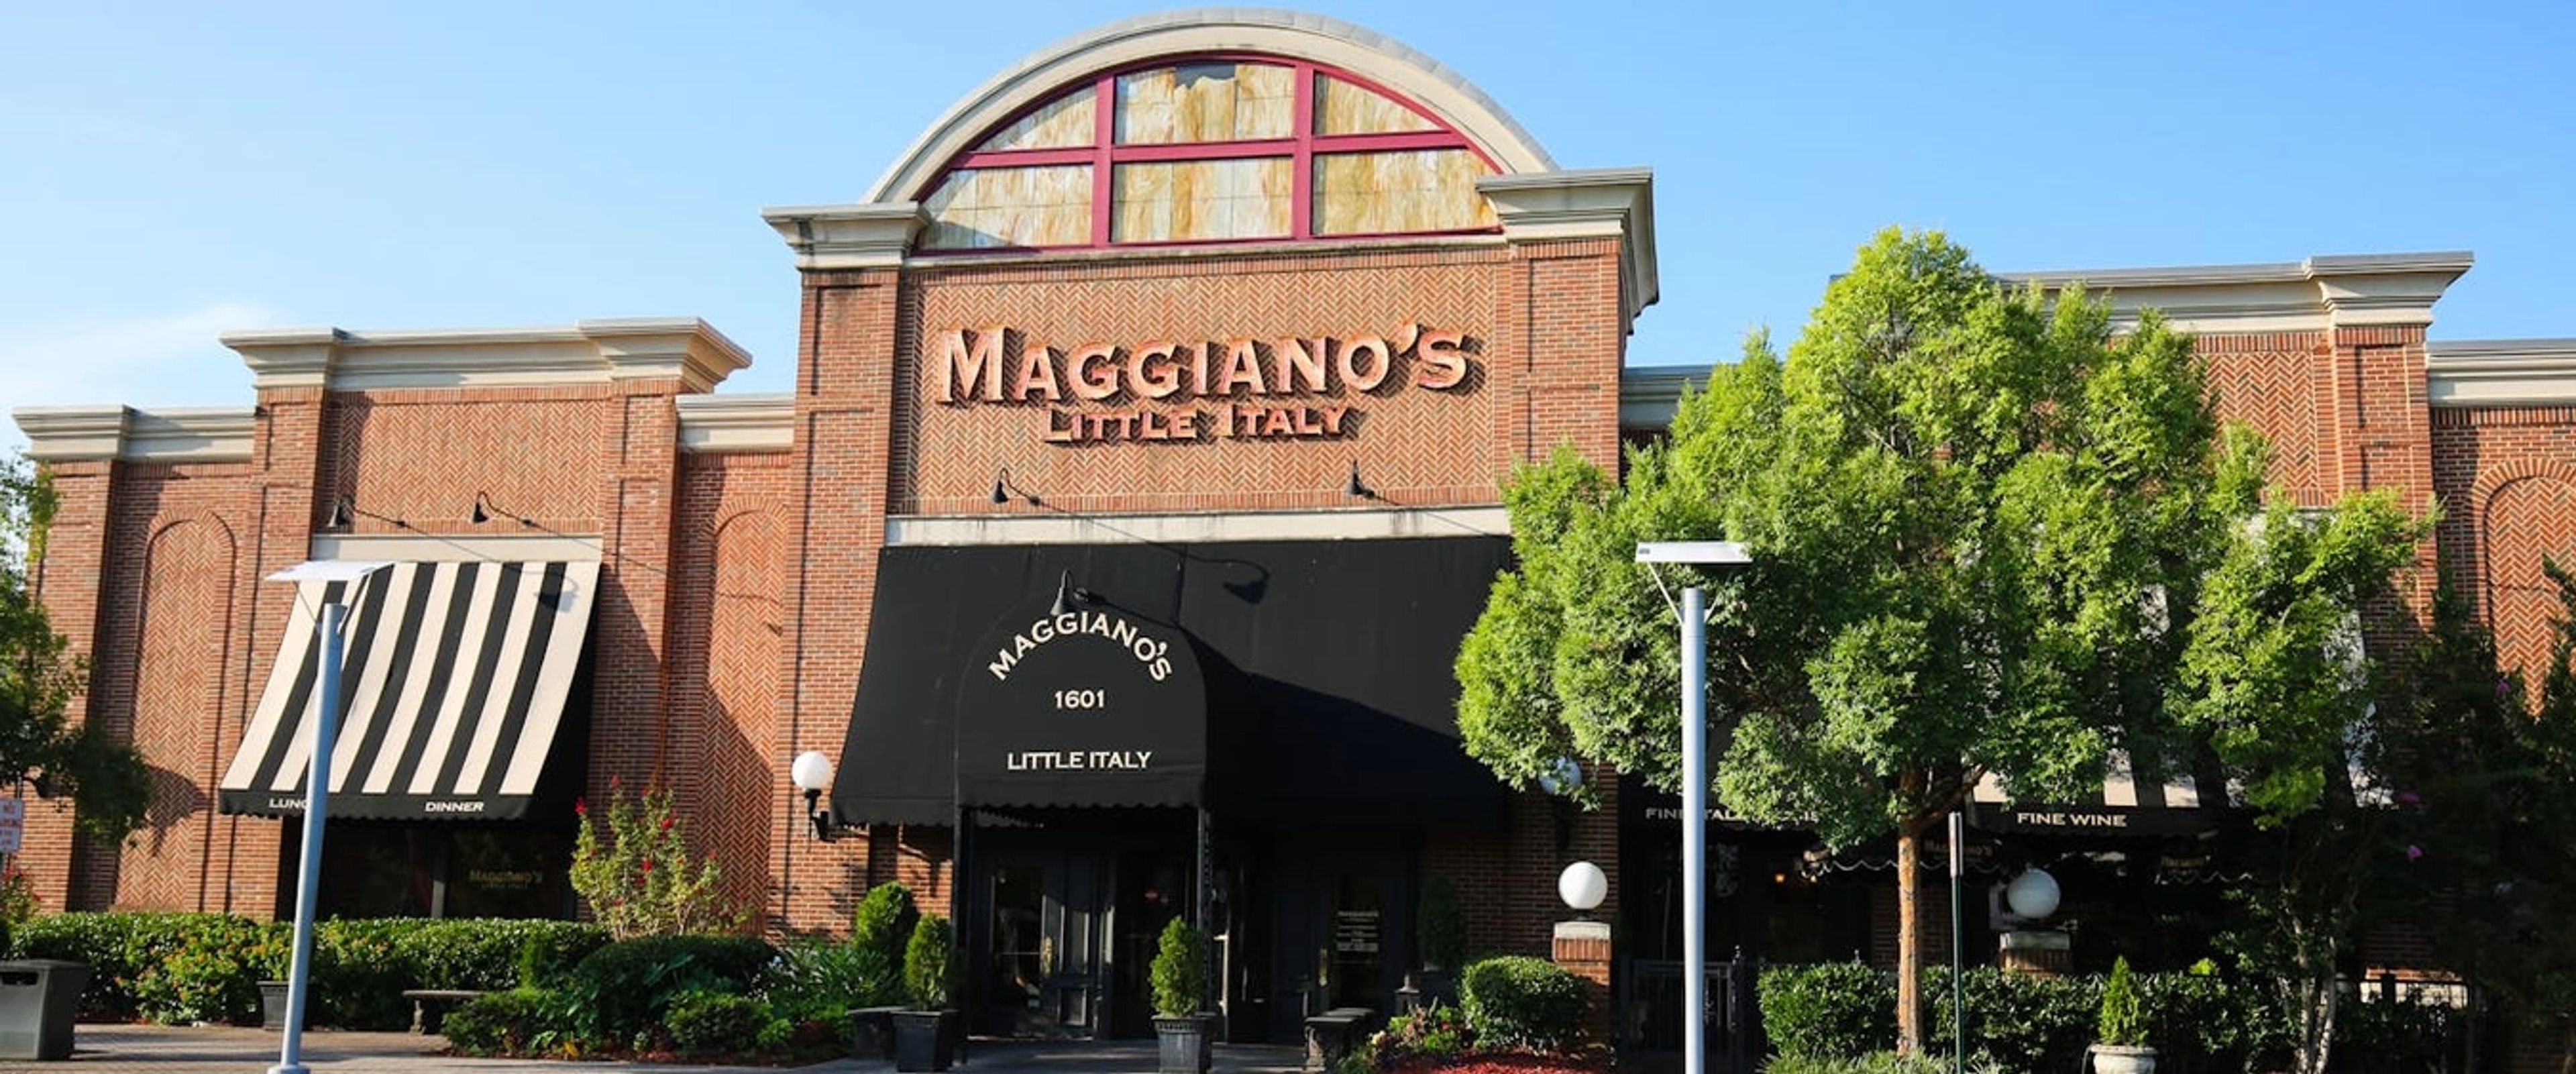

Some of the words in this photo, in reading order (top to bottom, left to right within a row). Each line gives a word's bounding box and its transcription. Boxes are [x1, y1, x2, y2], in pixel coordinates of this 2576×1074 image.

[937, 319, 1466, 402] MAGGIANO'S
[1040, 405, 1197, 441] LITTLE
[1217, 402, 1347, 437] ITALY
[988, 610, 1173, 682] MAGGIANO'S
[1055, 690, 1105, 709] 1601
[1008, 752, 1085, 770] LITTLE
[1089, 751, 1152, 769] ITALY
[269, 798, 307, 810] LUNC
[425, 801, 484, 812] DINNER
[2017, 812, 2066, 825] FINE
[2070, 814, 2127, 827] WINE
